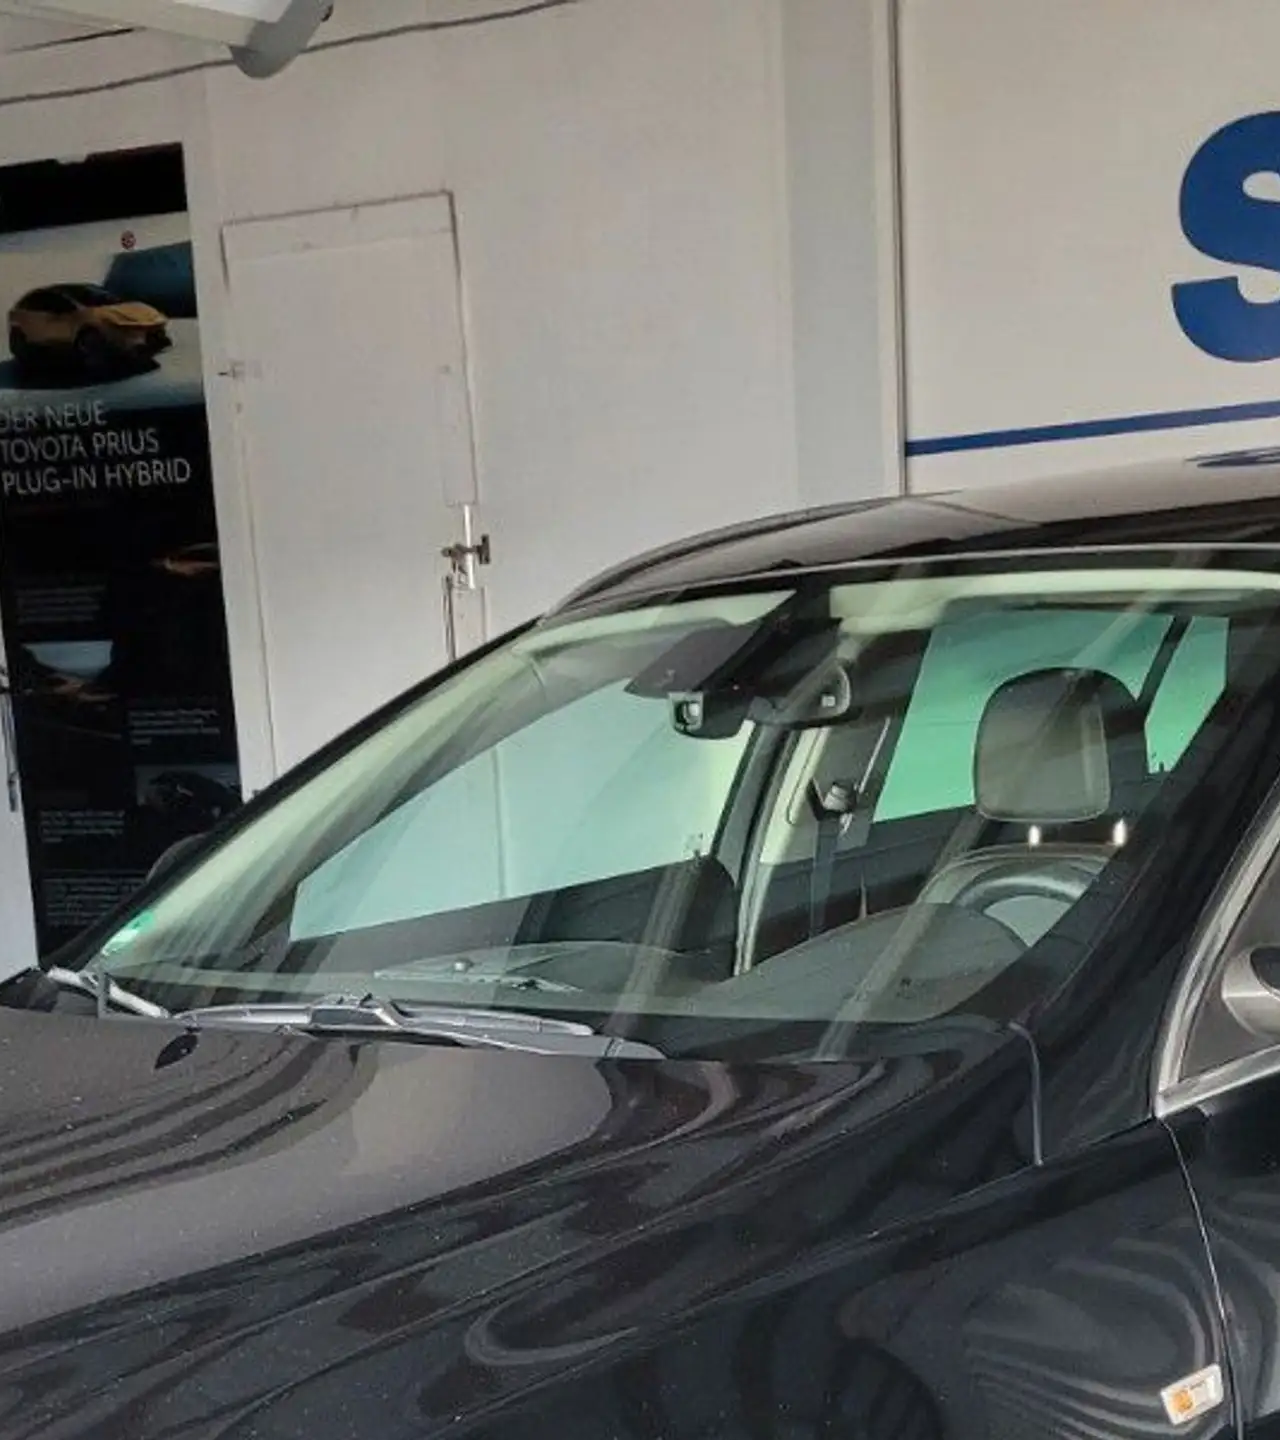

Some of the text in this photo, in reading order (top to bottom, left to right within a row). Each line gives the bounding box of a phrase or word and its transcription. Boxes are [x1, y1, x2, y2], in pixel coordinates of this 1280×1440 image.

[44, 399, 108, 428] NEUE
[0, 429, 159, 463] TOYOTA PRIUS
[2, 457, 192, 495] PLUG-IN HYBRID
